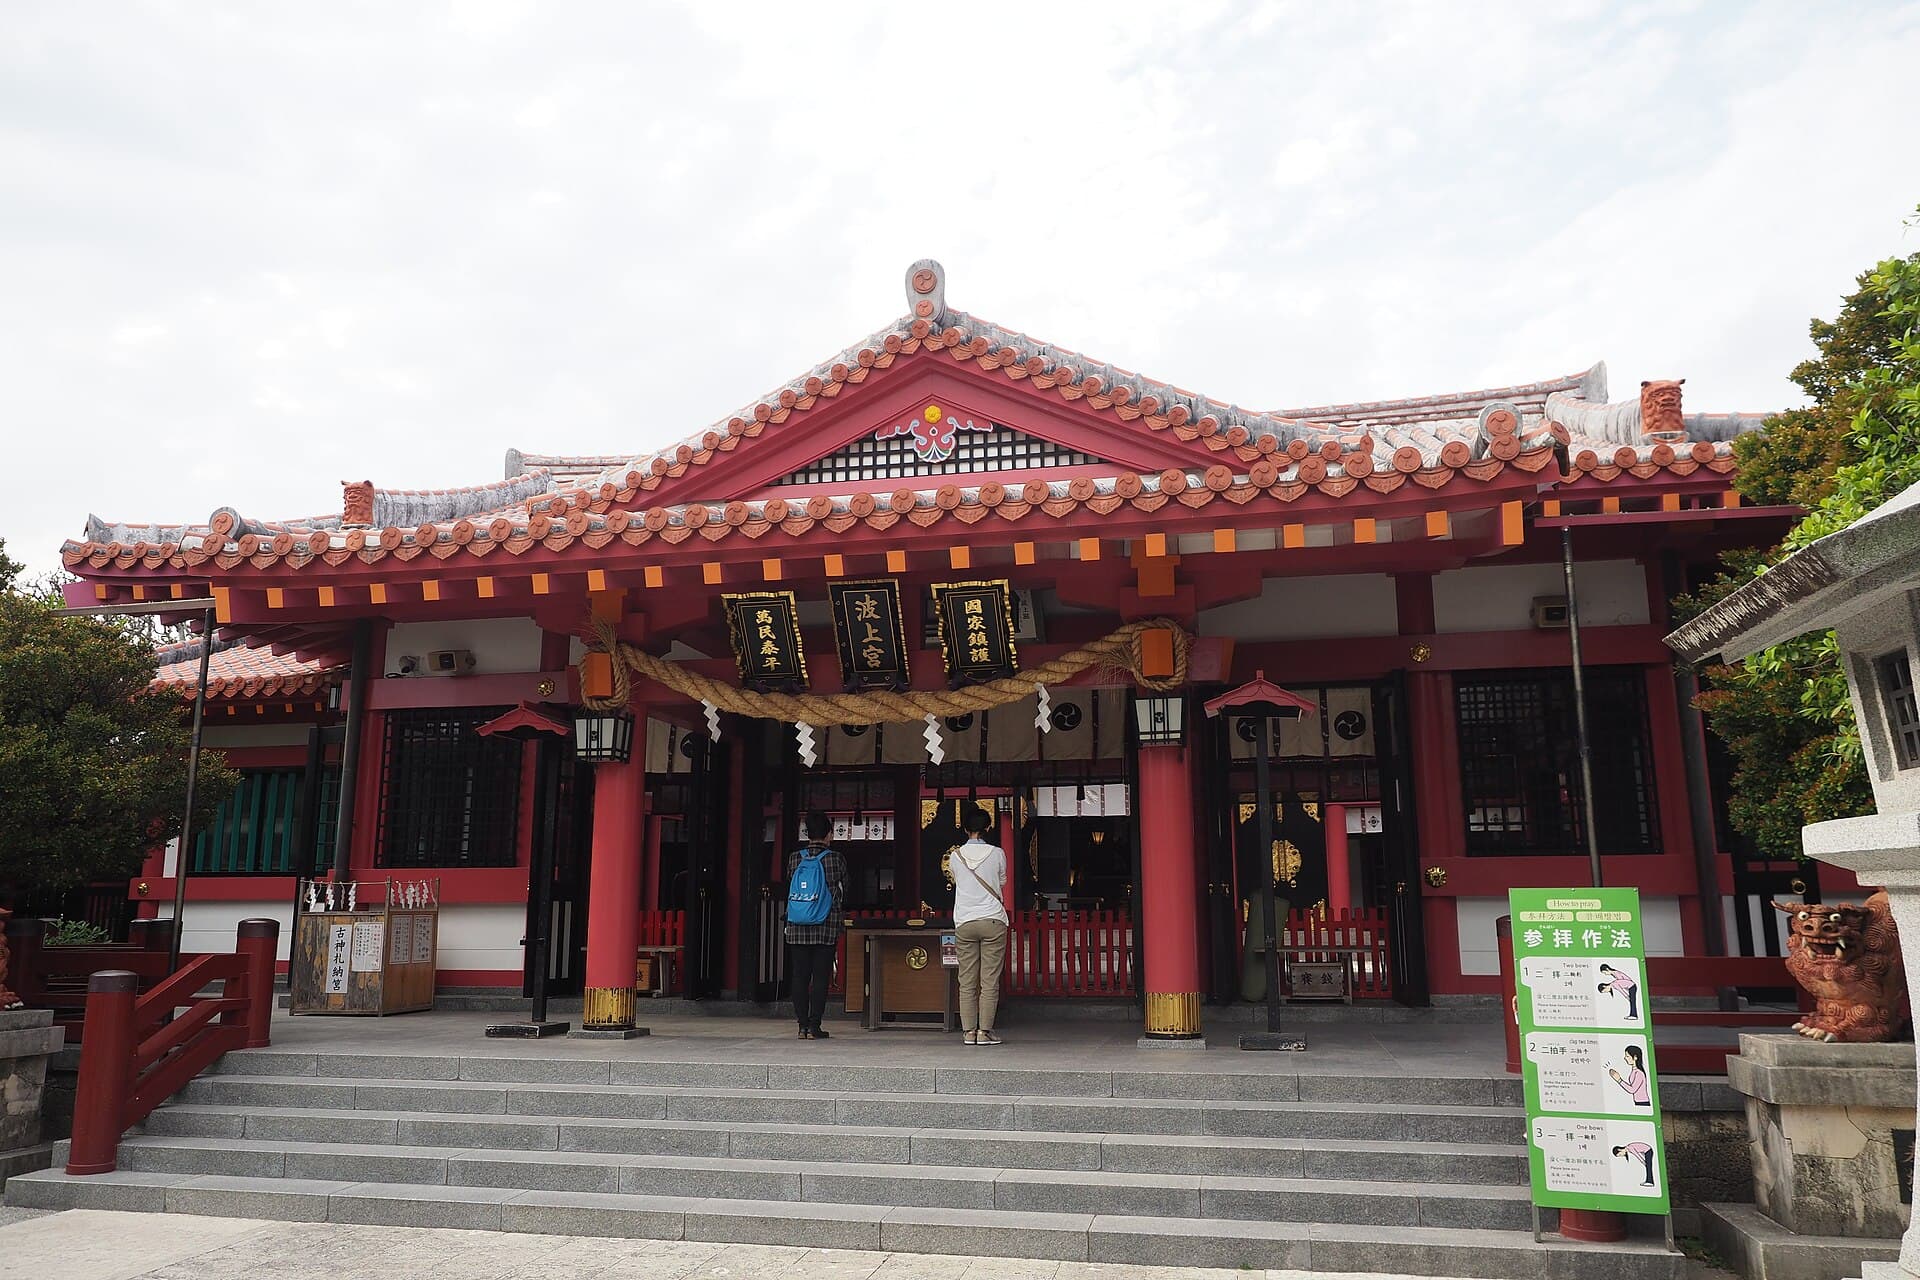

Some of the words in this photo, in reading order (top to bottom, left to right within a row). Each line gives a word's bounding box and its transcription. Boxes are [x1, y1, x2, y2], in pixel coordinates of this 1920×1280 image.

[855, 593, 885, 668] 波上宮
[755, 609, 781, 672] 萬民泰平
[1523, 929, 1632, 949] 参拝作法
[1530, 1042, 1536, 1052] 2
[1541, 1046, 1567, 1056] 二拍手
[1536, 1127, 1543, 1138] 3
